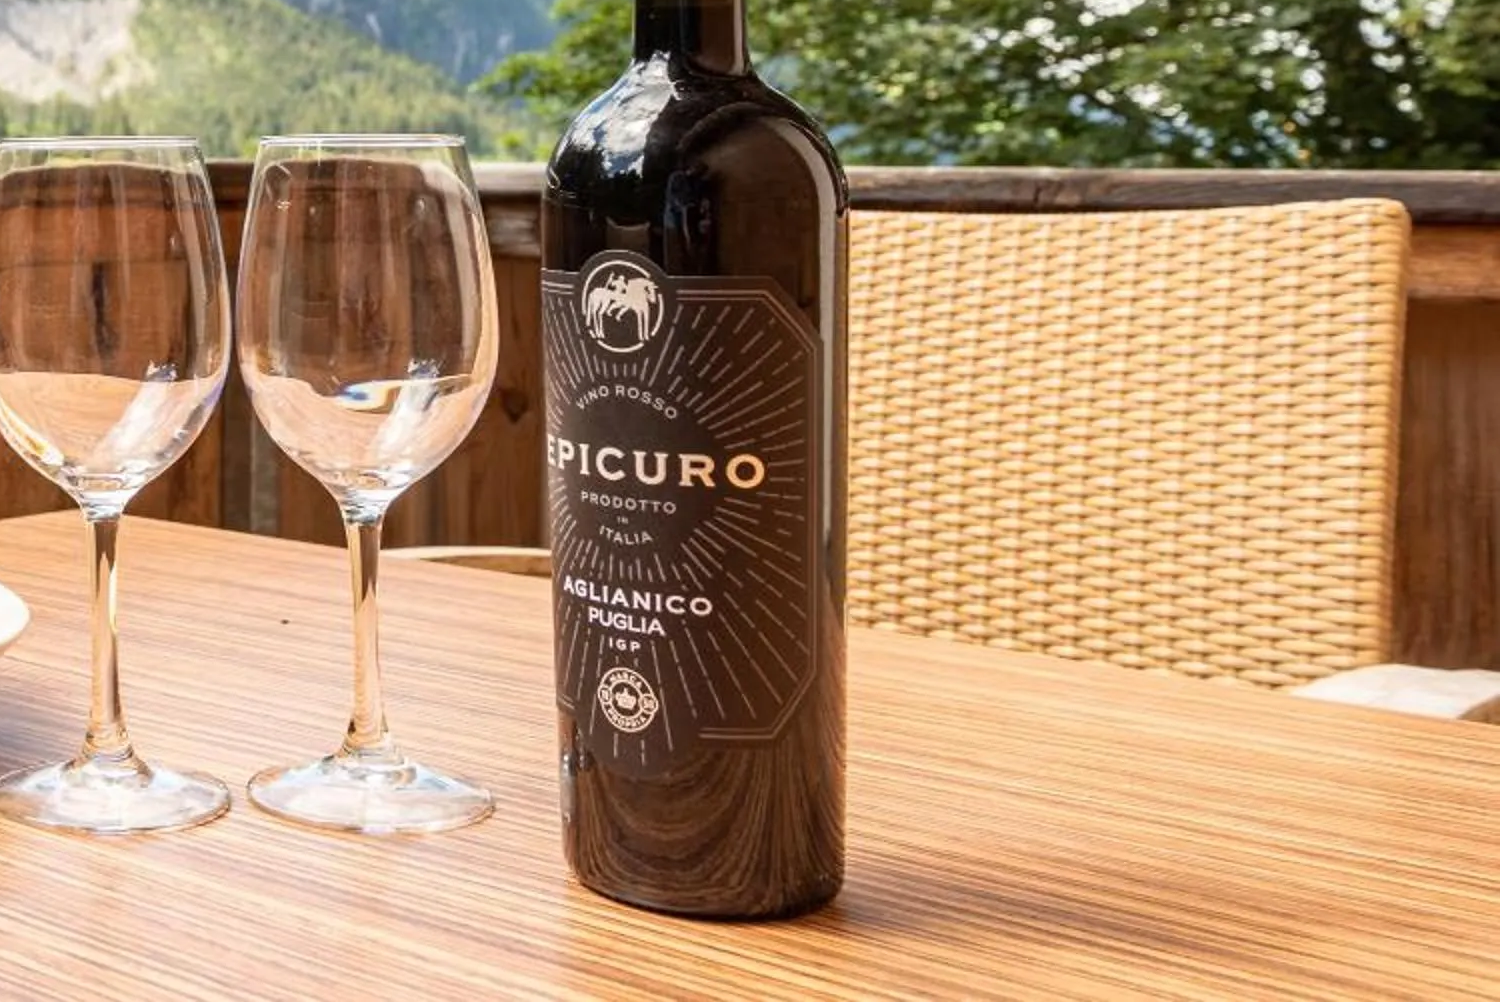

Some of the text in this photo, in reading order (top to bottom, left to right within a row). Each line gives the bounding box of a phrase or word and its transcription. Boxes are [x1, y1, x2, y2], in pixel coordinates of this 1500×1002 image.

[576, 384, 677, 419] VINO ROSSO
[547, 433, 766, 489] EPICURO
[581, 490, 676, 515] PRODOTTO
[600, 525, 653, 545] ITALIA
[563, 575, 713, 616] AGLIANICO
[588, 606, 666, 637] PUGLIA
[609, 637, 641, 652] IGP
